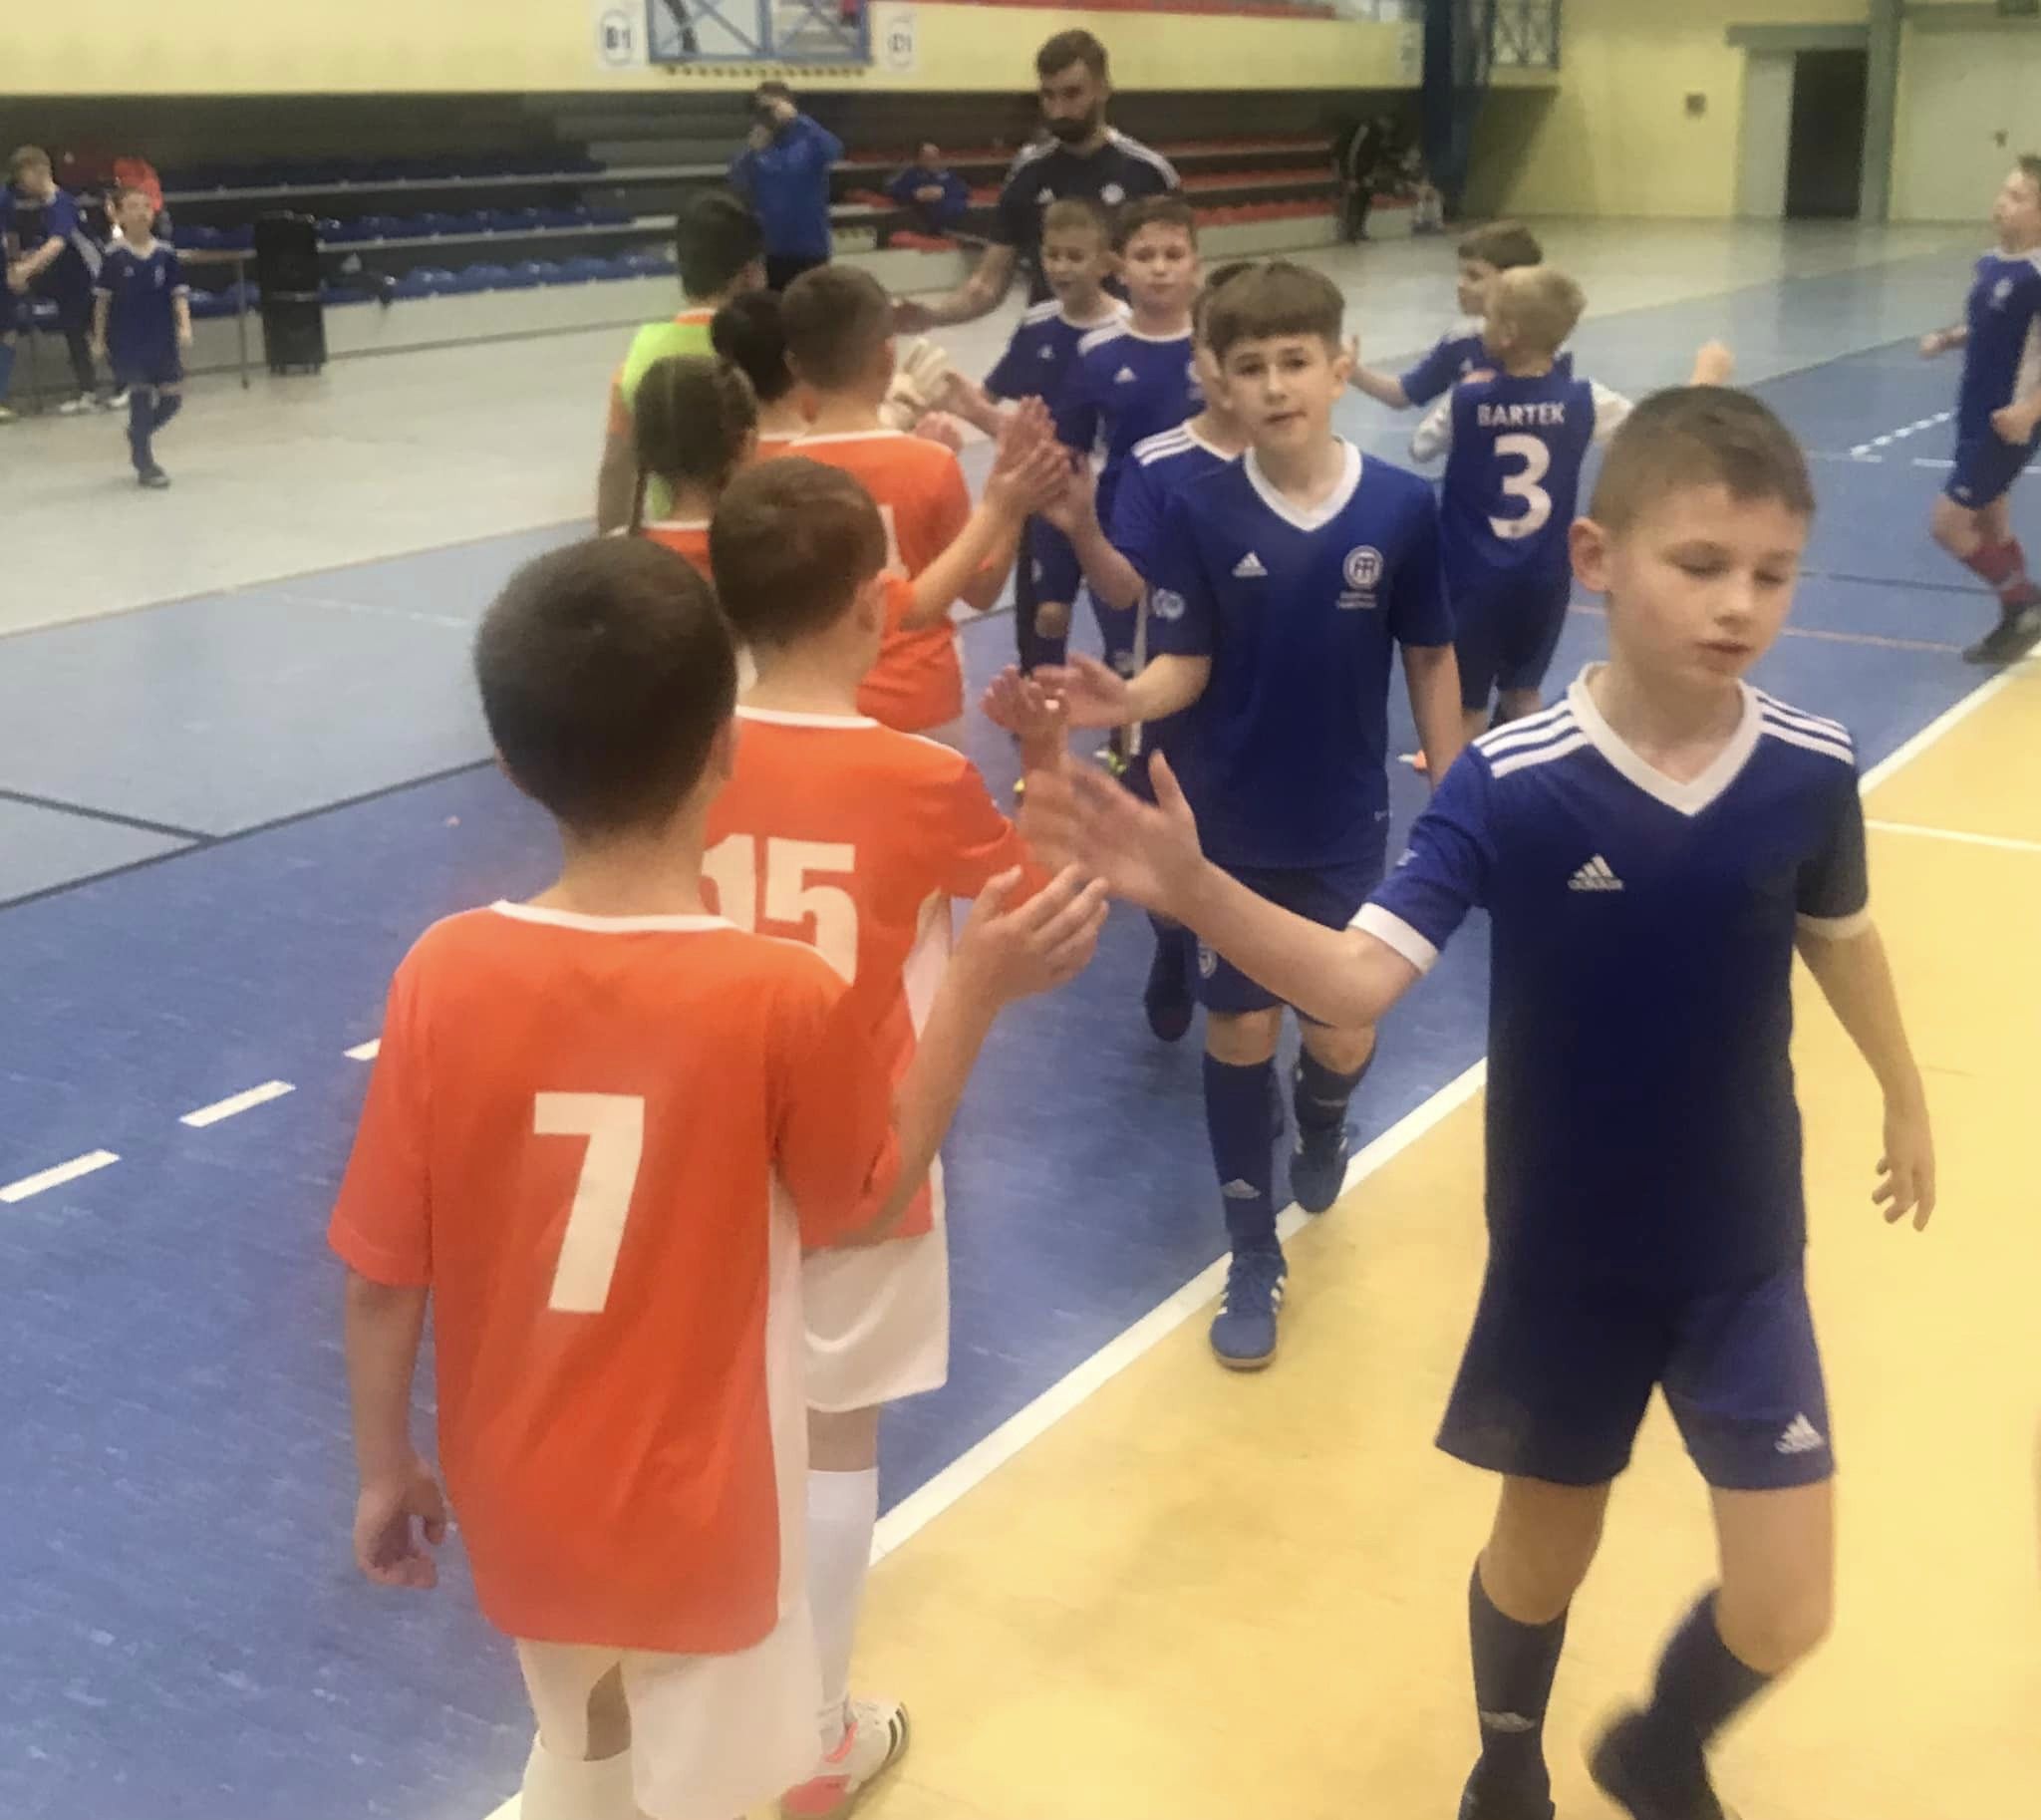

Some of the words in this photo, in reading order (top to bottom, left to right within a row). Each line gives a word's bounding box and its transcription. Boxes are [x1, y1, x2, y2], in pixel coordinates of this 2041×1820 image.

[1476, 401, 1567, 428] BARTEK
[1487, 431, 1554, 540] 3
[701, 832, 859, 988] 15
[532, 1090, 646, 1314] 7
